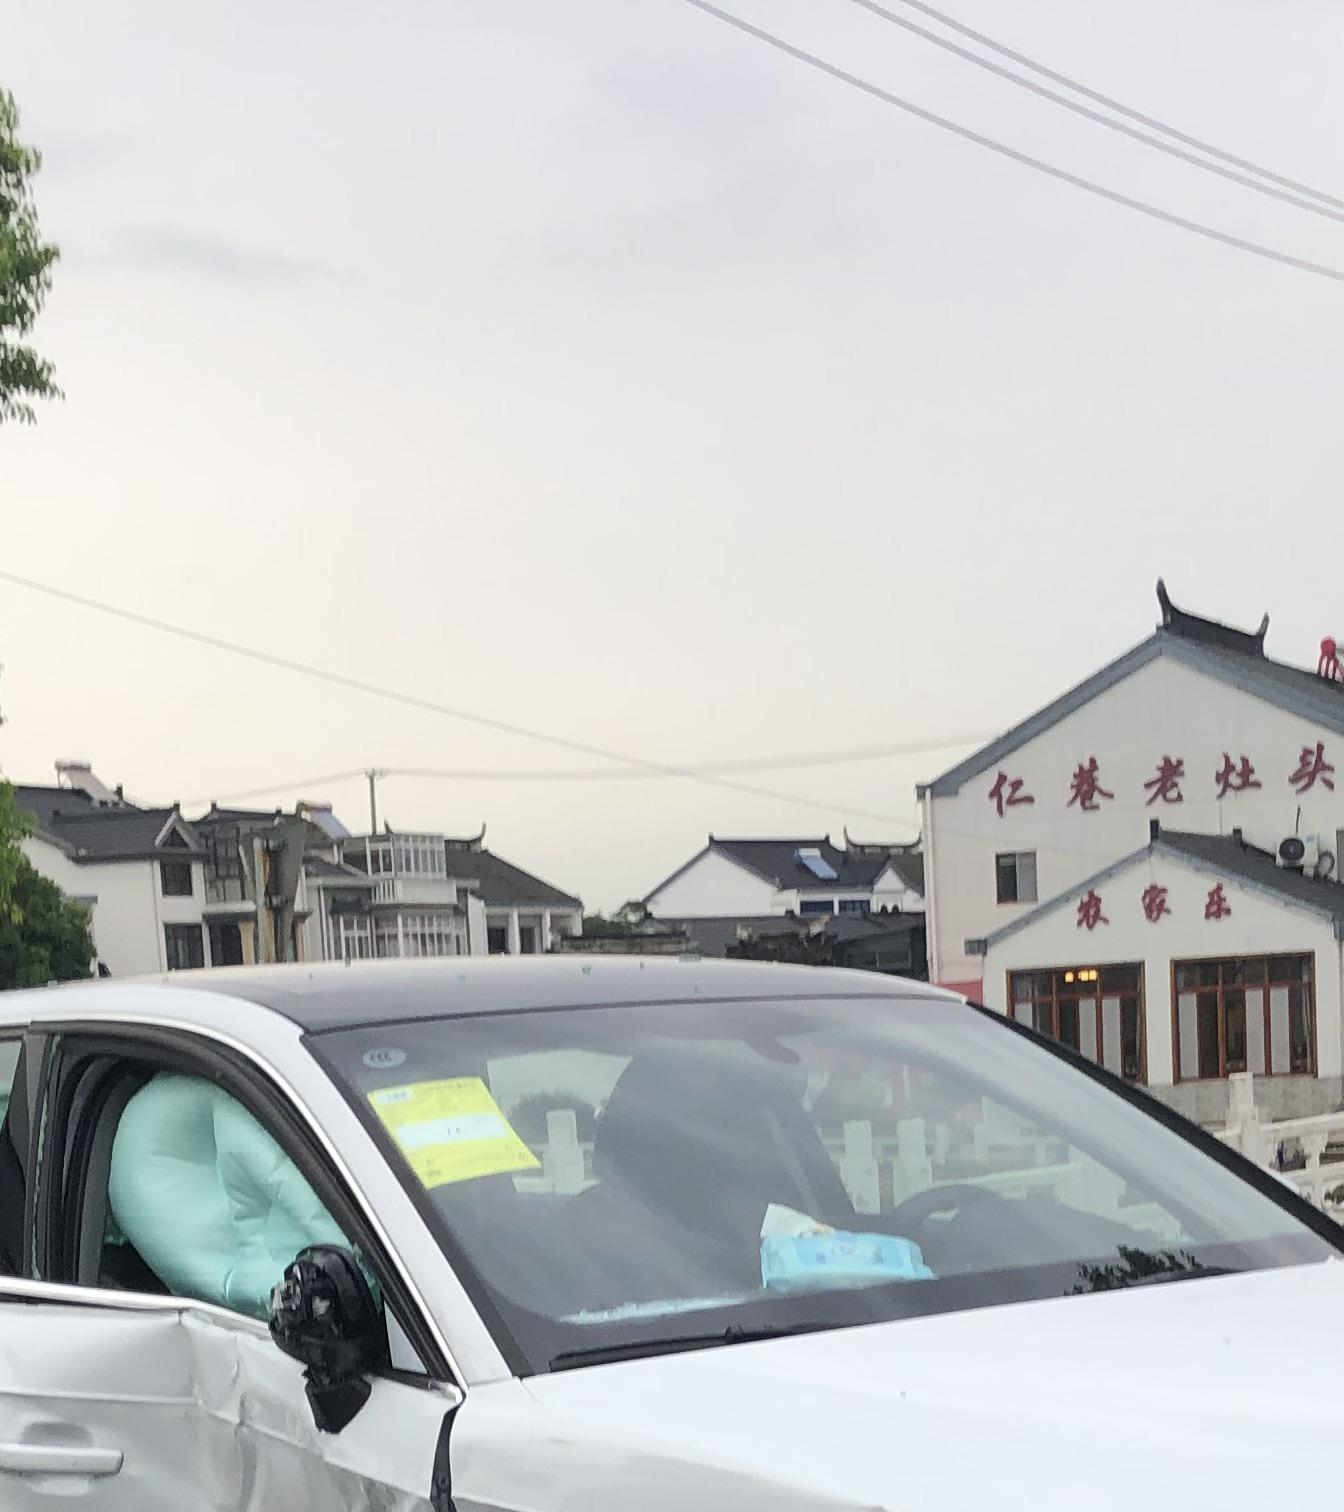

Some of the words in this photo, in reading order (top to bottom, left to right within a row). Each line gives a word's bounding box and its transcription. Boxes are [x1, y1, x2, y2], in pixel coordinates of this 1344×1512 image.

[988, 740, 1336, 818] 仁巷老灶头
